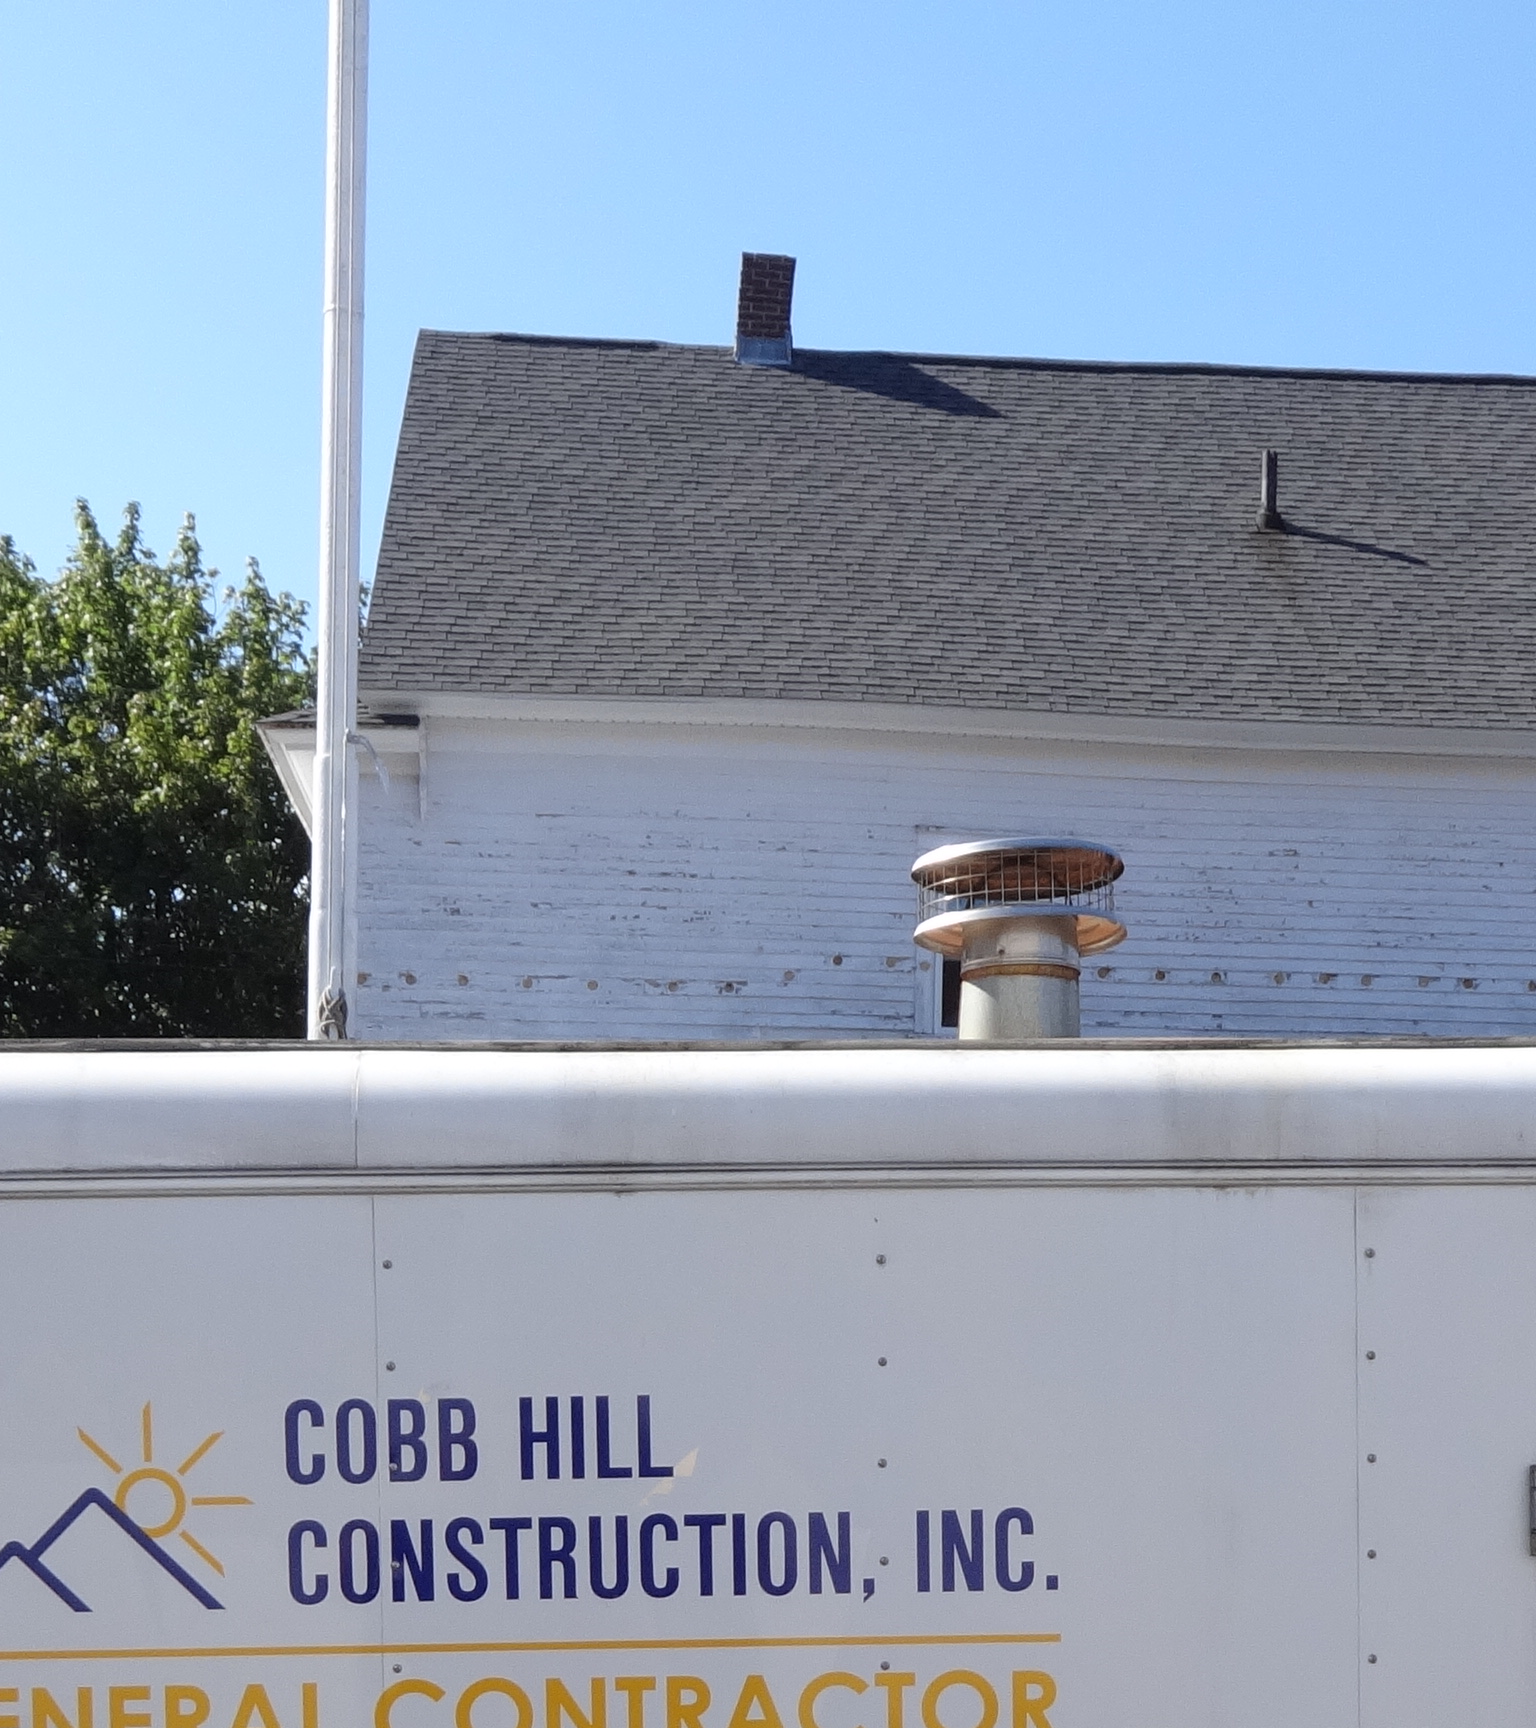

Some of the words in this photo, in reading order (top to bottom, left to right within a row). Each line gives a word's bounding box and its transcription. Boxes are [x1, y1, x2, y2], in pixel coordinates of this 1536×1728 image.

[284, 1397, 479, 1486] COBB
[519, 1394, 674, 1481] HILL
[287, 1511, 875, 1606] CONSTRUCTION,
[916, 1507, 1059, 1593] INC.
